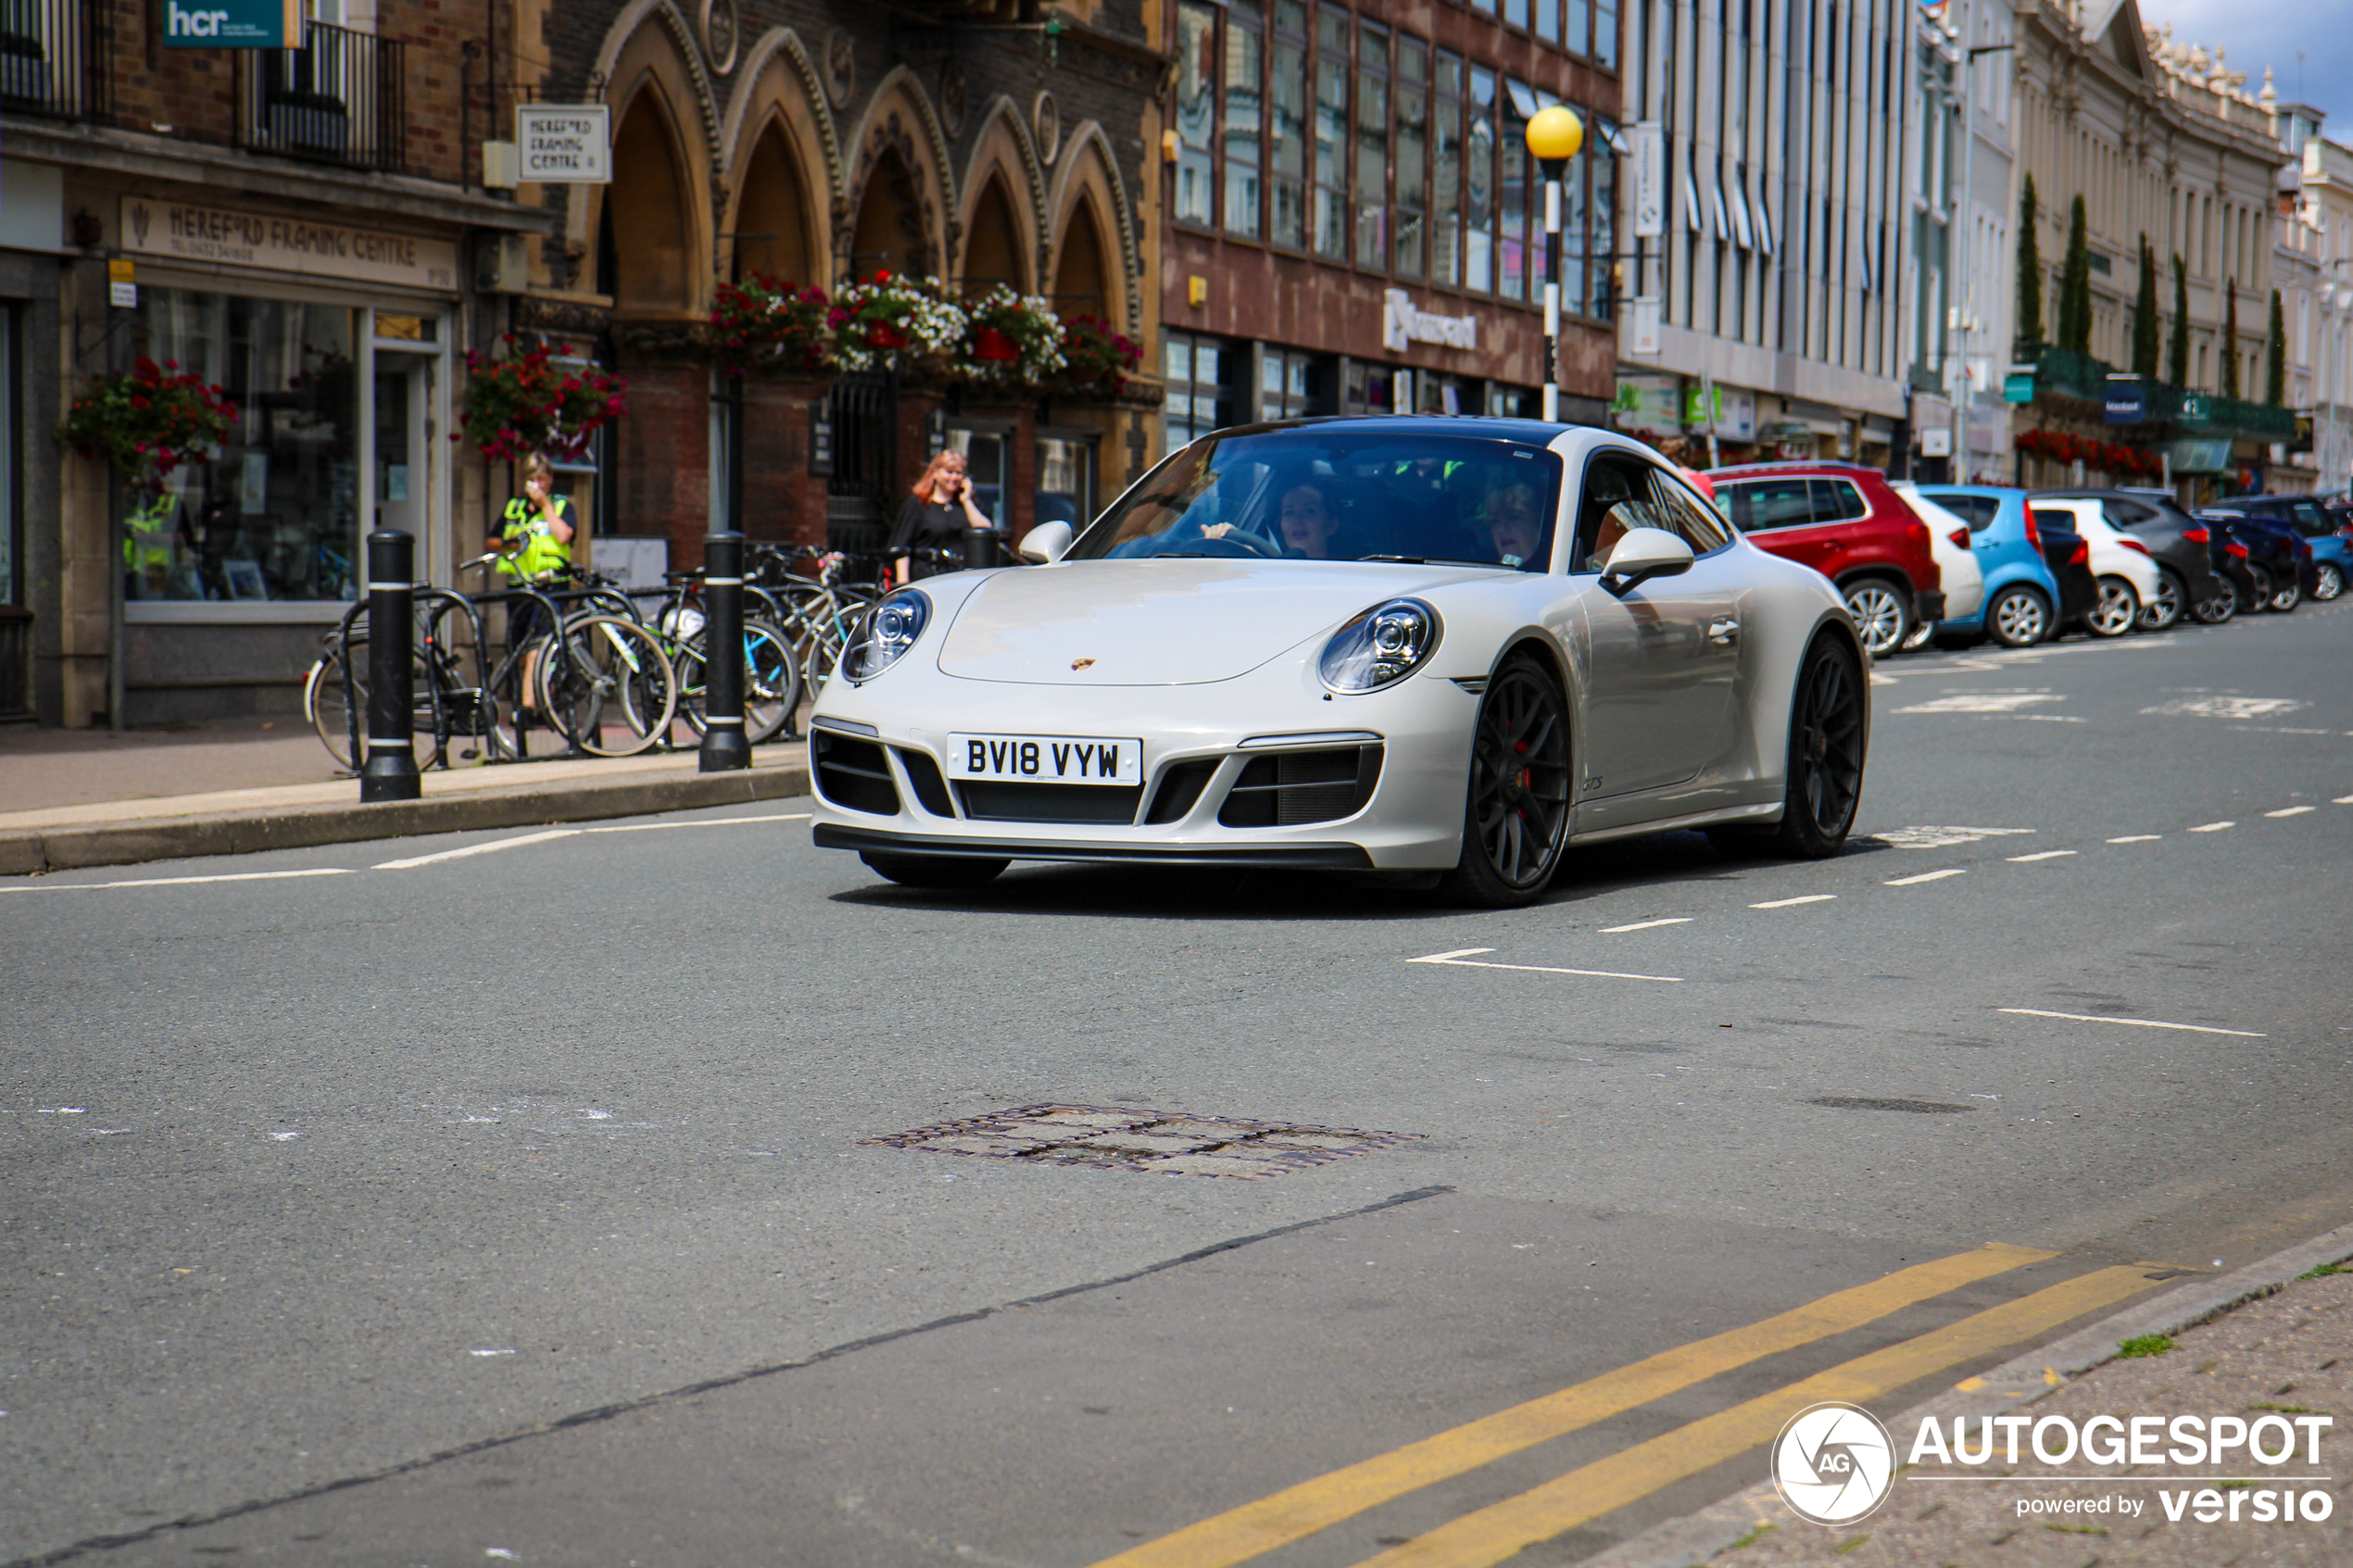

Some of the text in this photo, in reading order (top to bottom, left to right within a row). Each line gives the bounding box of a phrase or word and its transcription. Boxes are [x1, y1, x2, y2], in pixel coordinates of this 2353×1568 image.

[169, 0, 229, 36] hcr
[531, 119, 592, 134] HEREFORD
[531, 137, 583, 152] FRAMING
[531, 154, 579, 169] CENTRE
[170, 207, 416, 268] HEREFORD FRAMING CENTRE
[968, 740, 1118, 777] BV18 VYW
[1582, 775, 1604, 792] GTS
